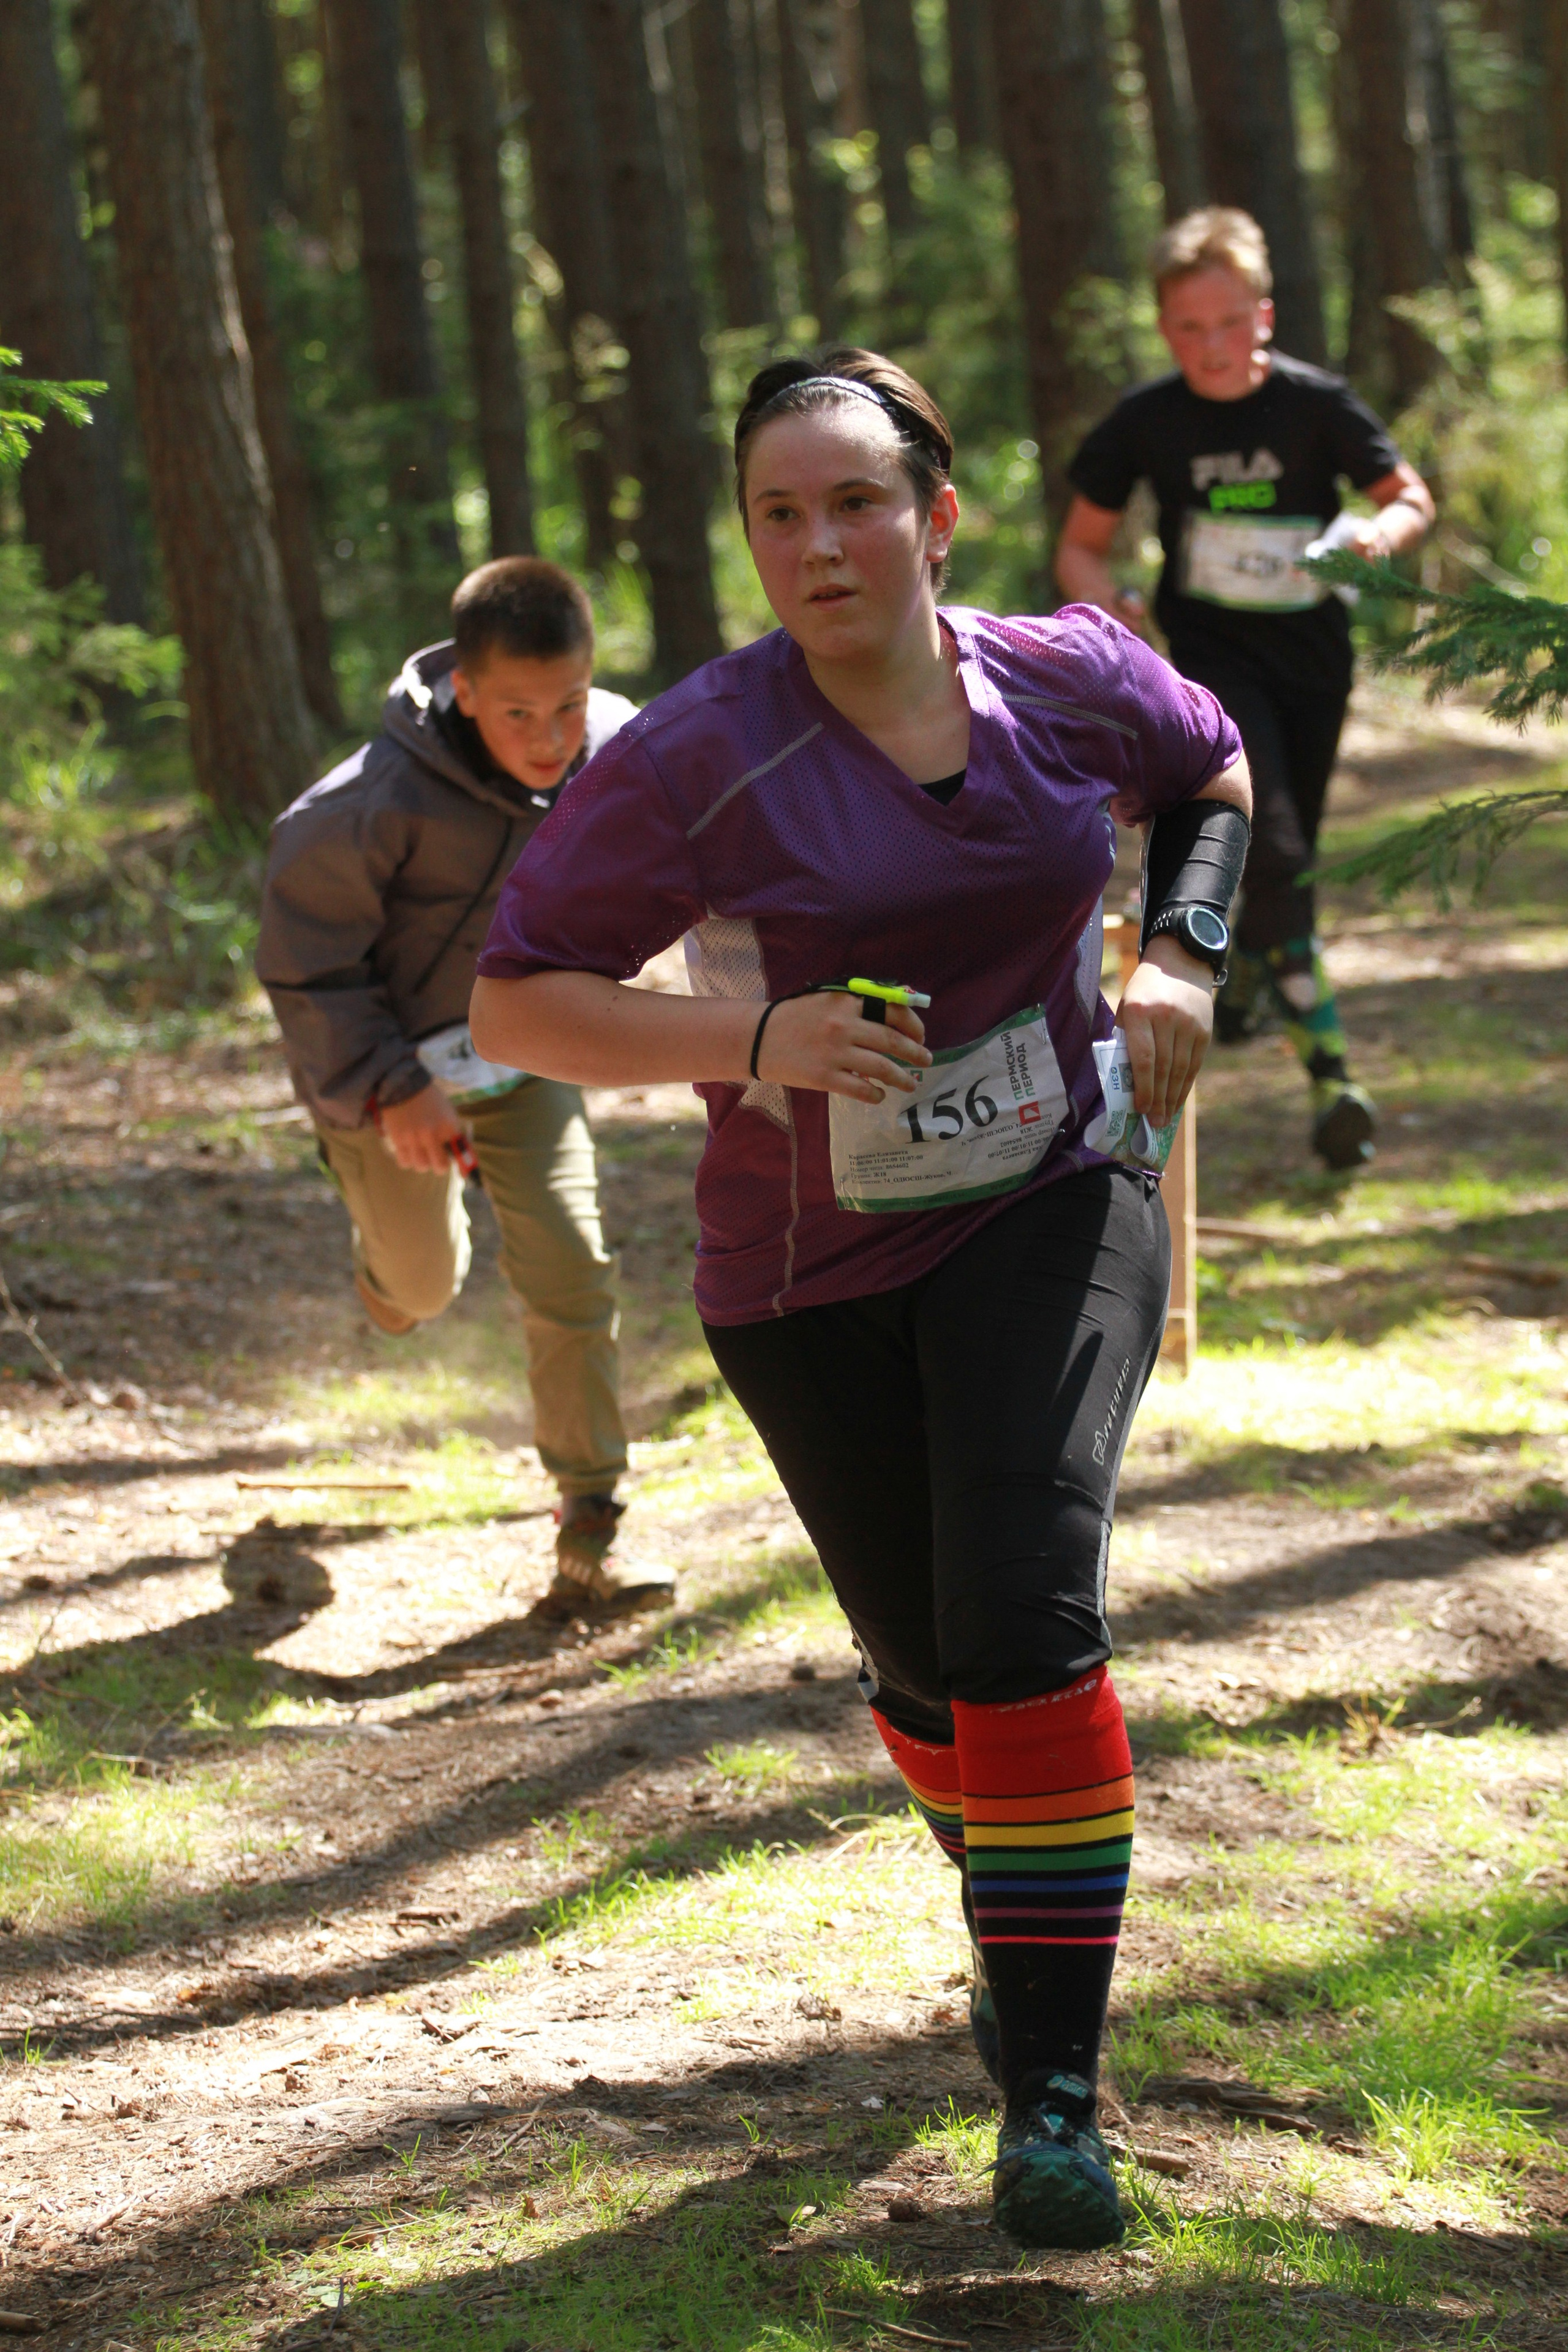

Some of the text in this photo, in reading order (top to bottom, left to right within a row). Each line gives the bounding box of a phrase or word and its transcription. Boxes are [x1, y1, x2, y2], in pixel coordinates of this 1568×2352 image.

[1001, 1031, 1023, 1100] ПЕРМСКИЙ
[1017, 1042, 1035, 1096] ПЕРИОД
[900, 1076, 998, 1144] 156
[988, 1148, 1010, 1158] 11:07:00
[1000, 1137, 1022, 1147] 8654602
[1011, 1142, 1033, 1150] 11:01:00
